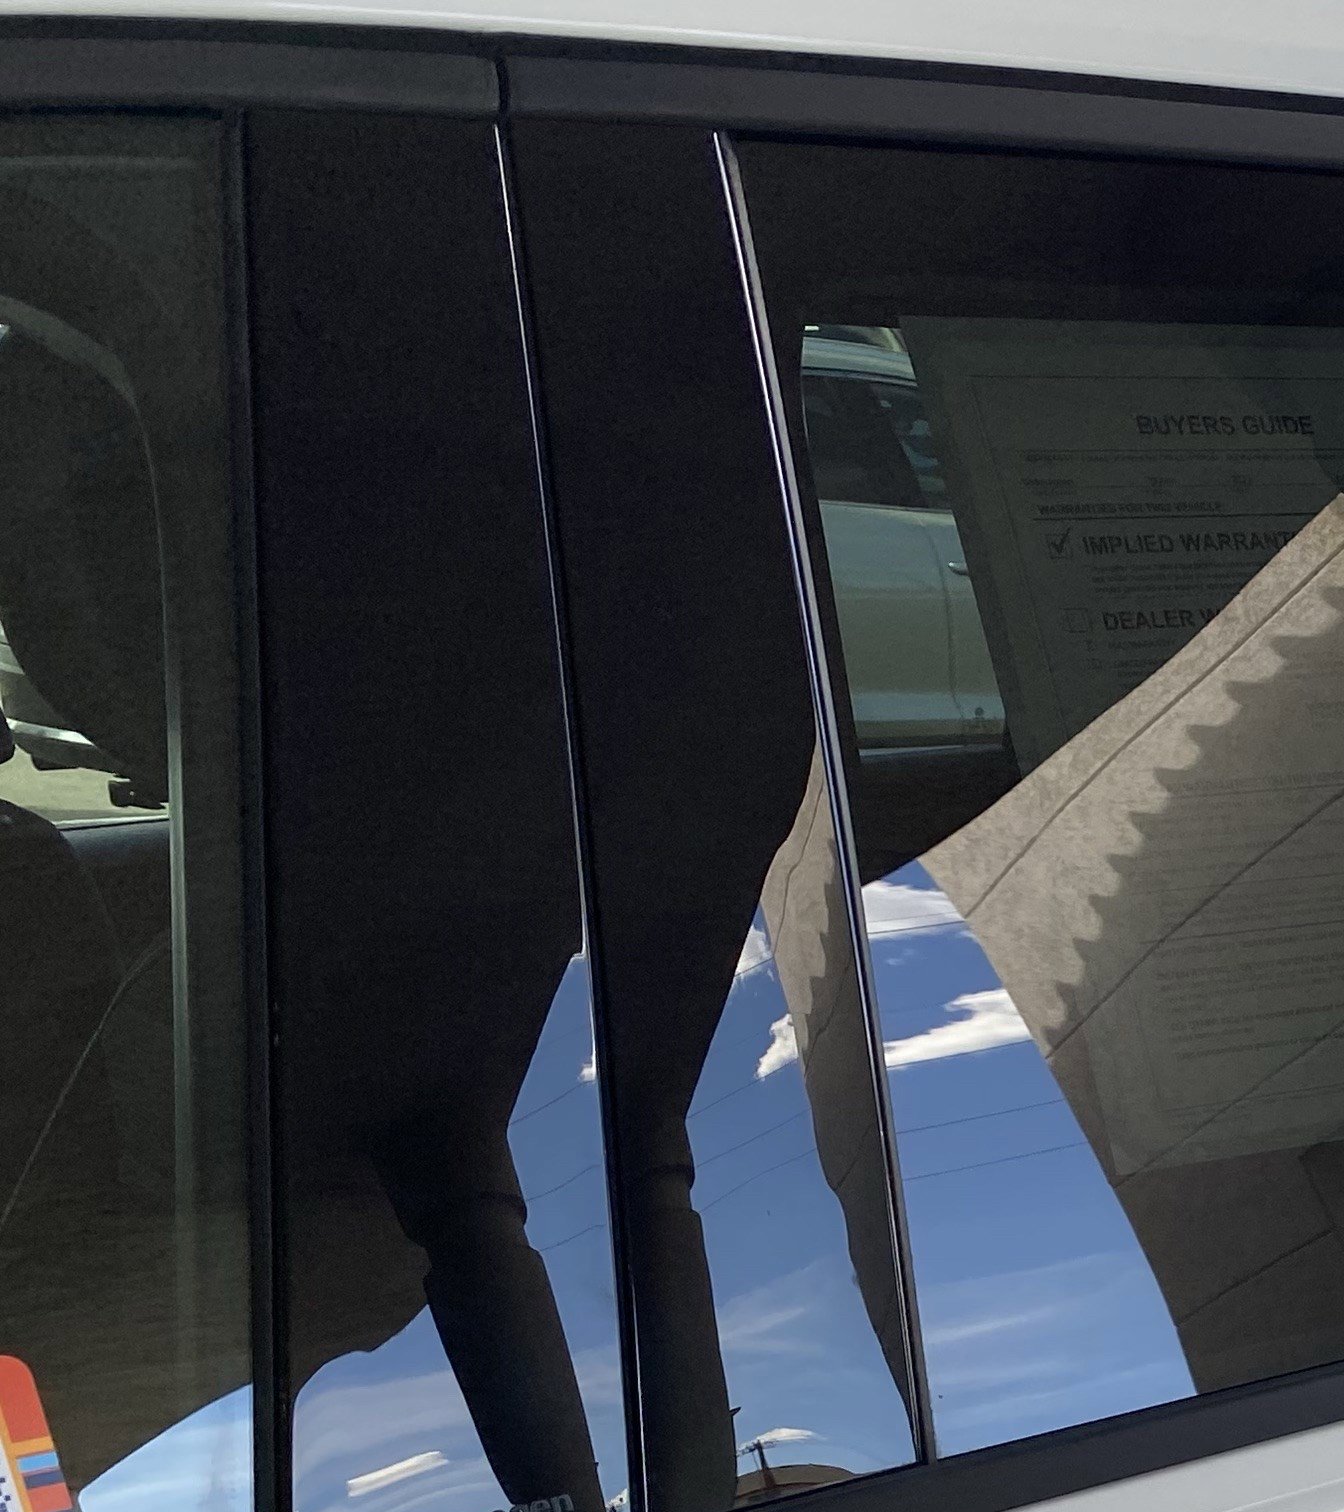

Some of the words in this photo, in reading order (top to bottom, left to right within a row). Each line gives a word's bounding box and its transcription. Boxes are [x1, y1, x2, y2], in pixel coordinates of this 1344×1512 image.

[1136, 414, 1235, 436] BUYERS
[1242, 413, 1315, 436] GUIDE
[1081, 534, 1175, 555] IMPLIED
[1101, 609, 1196, 631] DEALER
